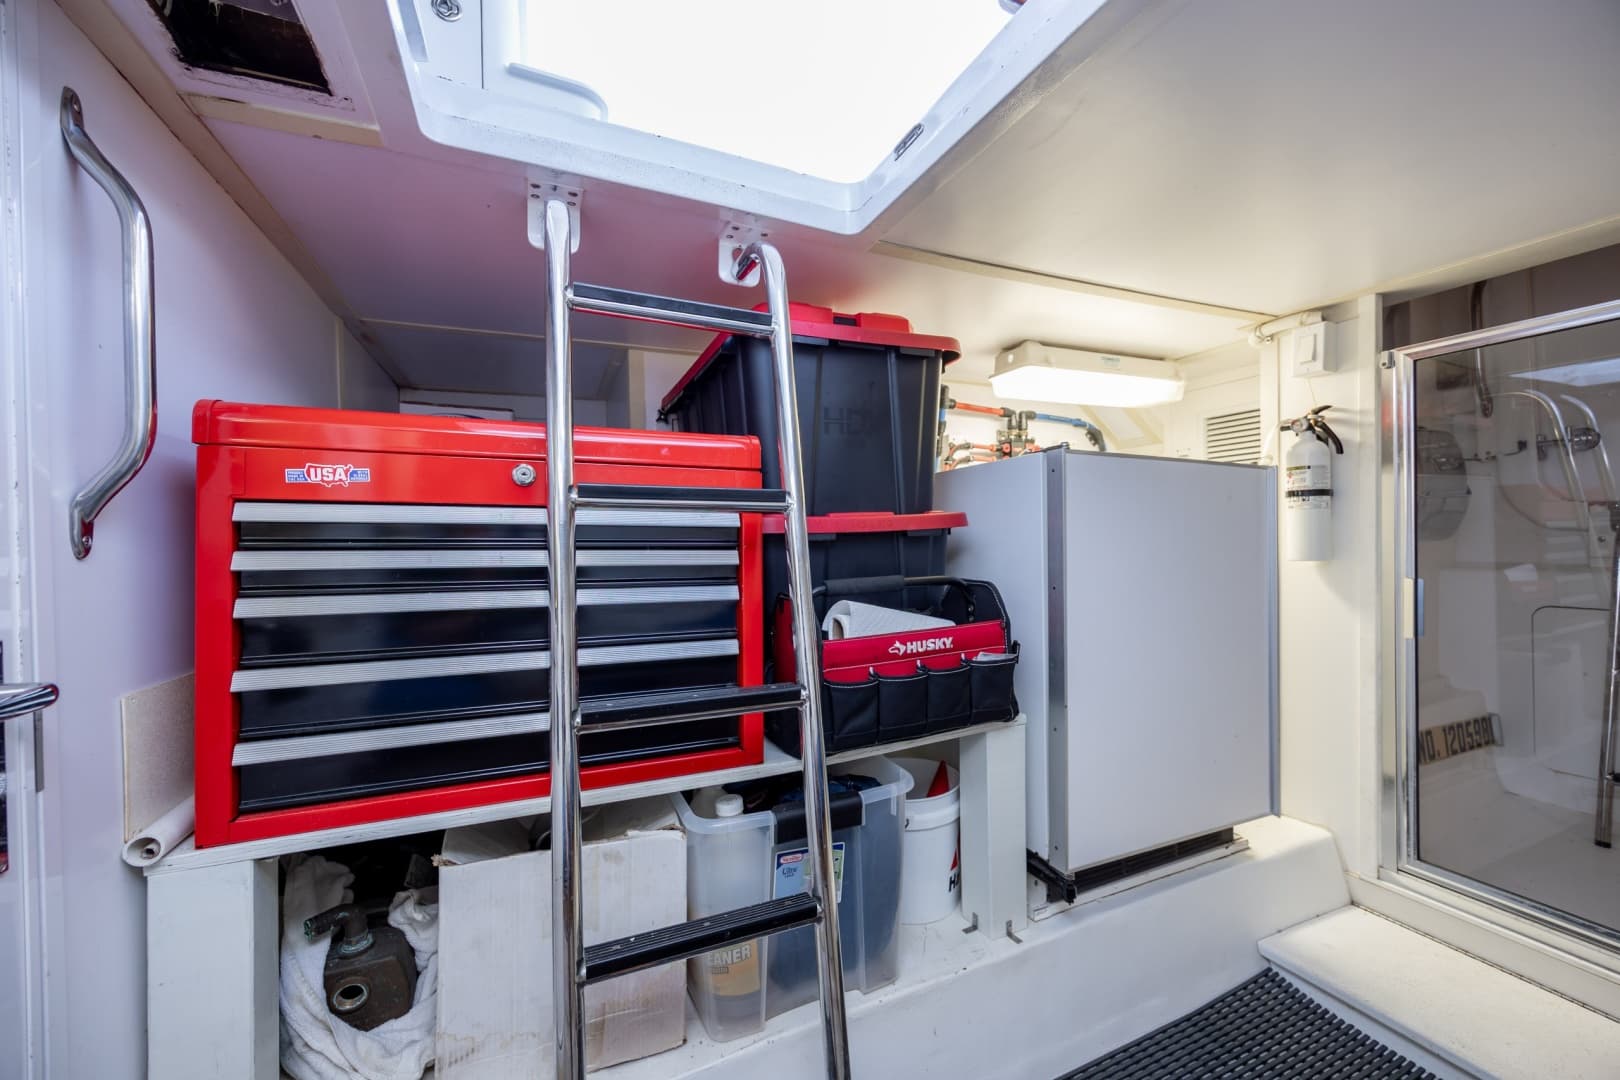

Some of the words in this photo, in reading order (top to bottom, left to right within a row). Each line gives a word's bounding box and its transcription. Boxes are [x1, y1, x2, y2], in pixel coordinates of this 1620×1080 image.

[309, 467, 347, 481] USA
[906, 637, 953, 654] HUSKY
[708, 944, 752, 966] EANER
